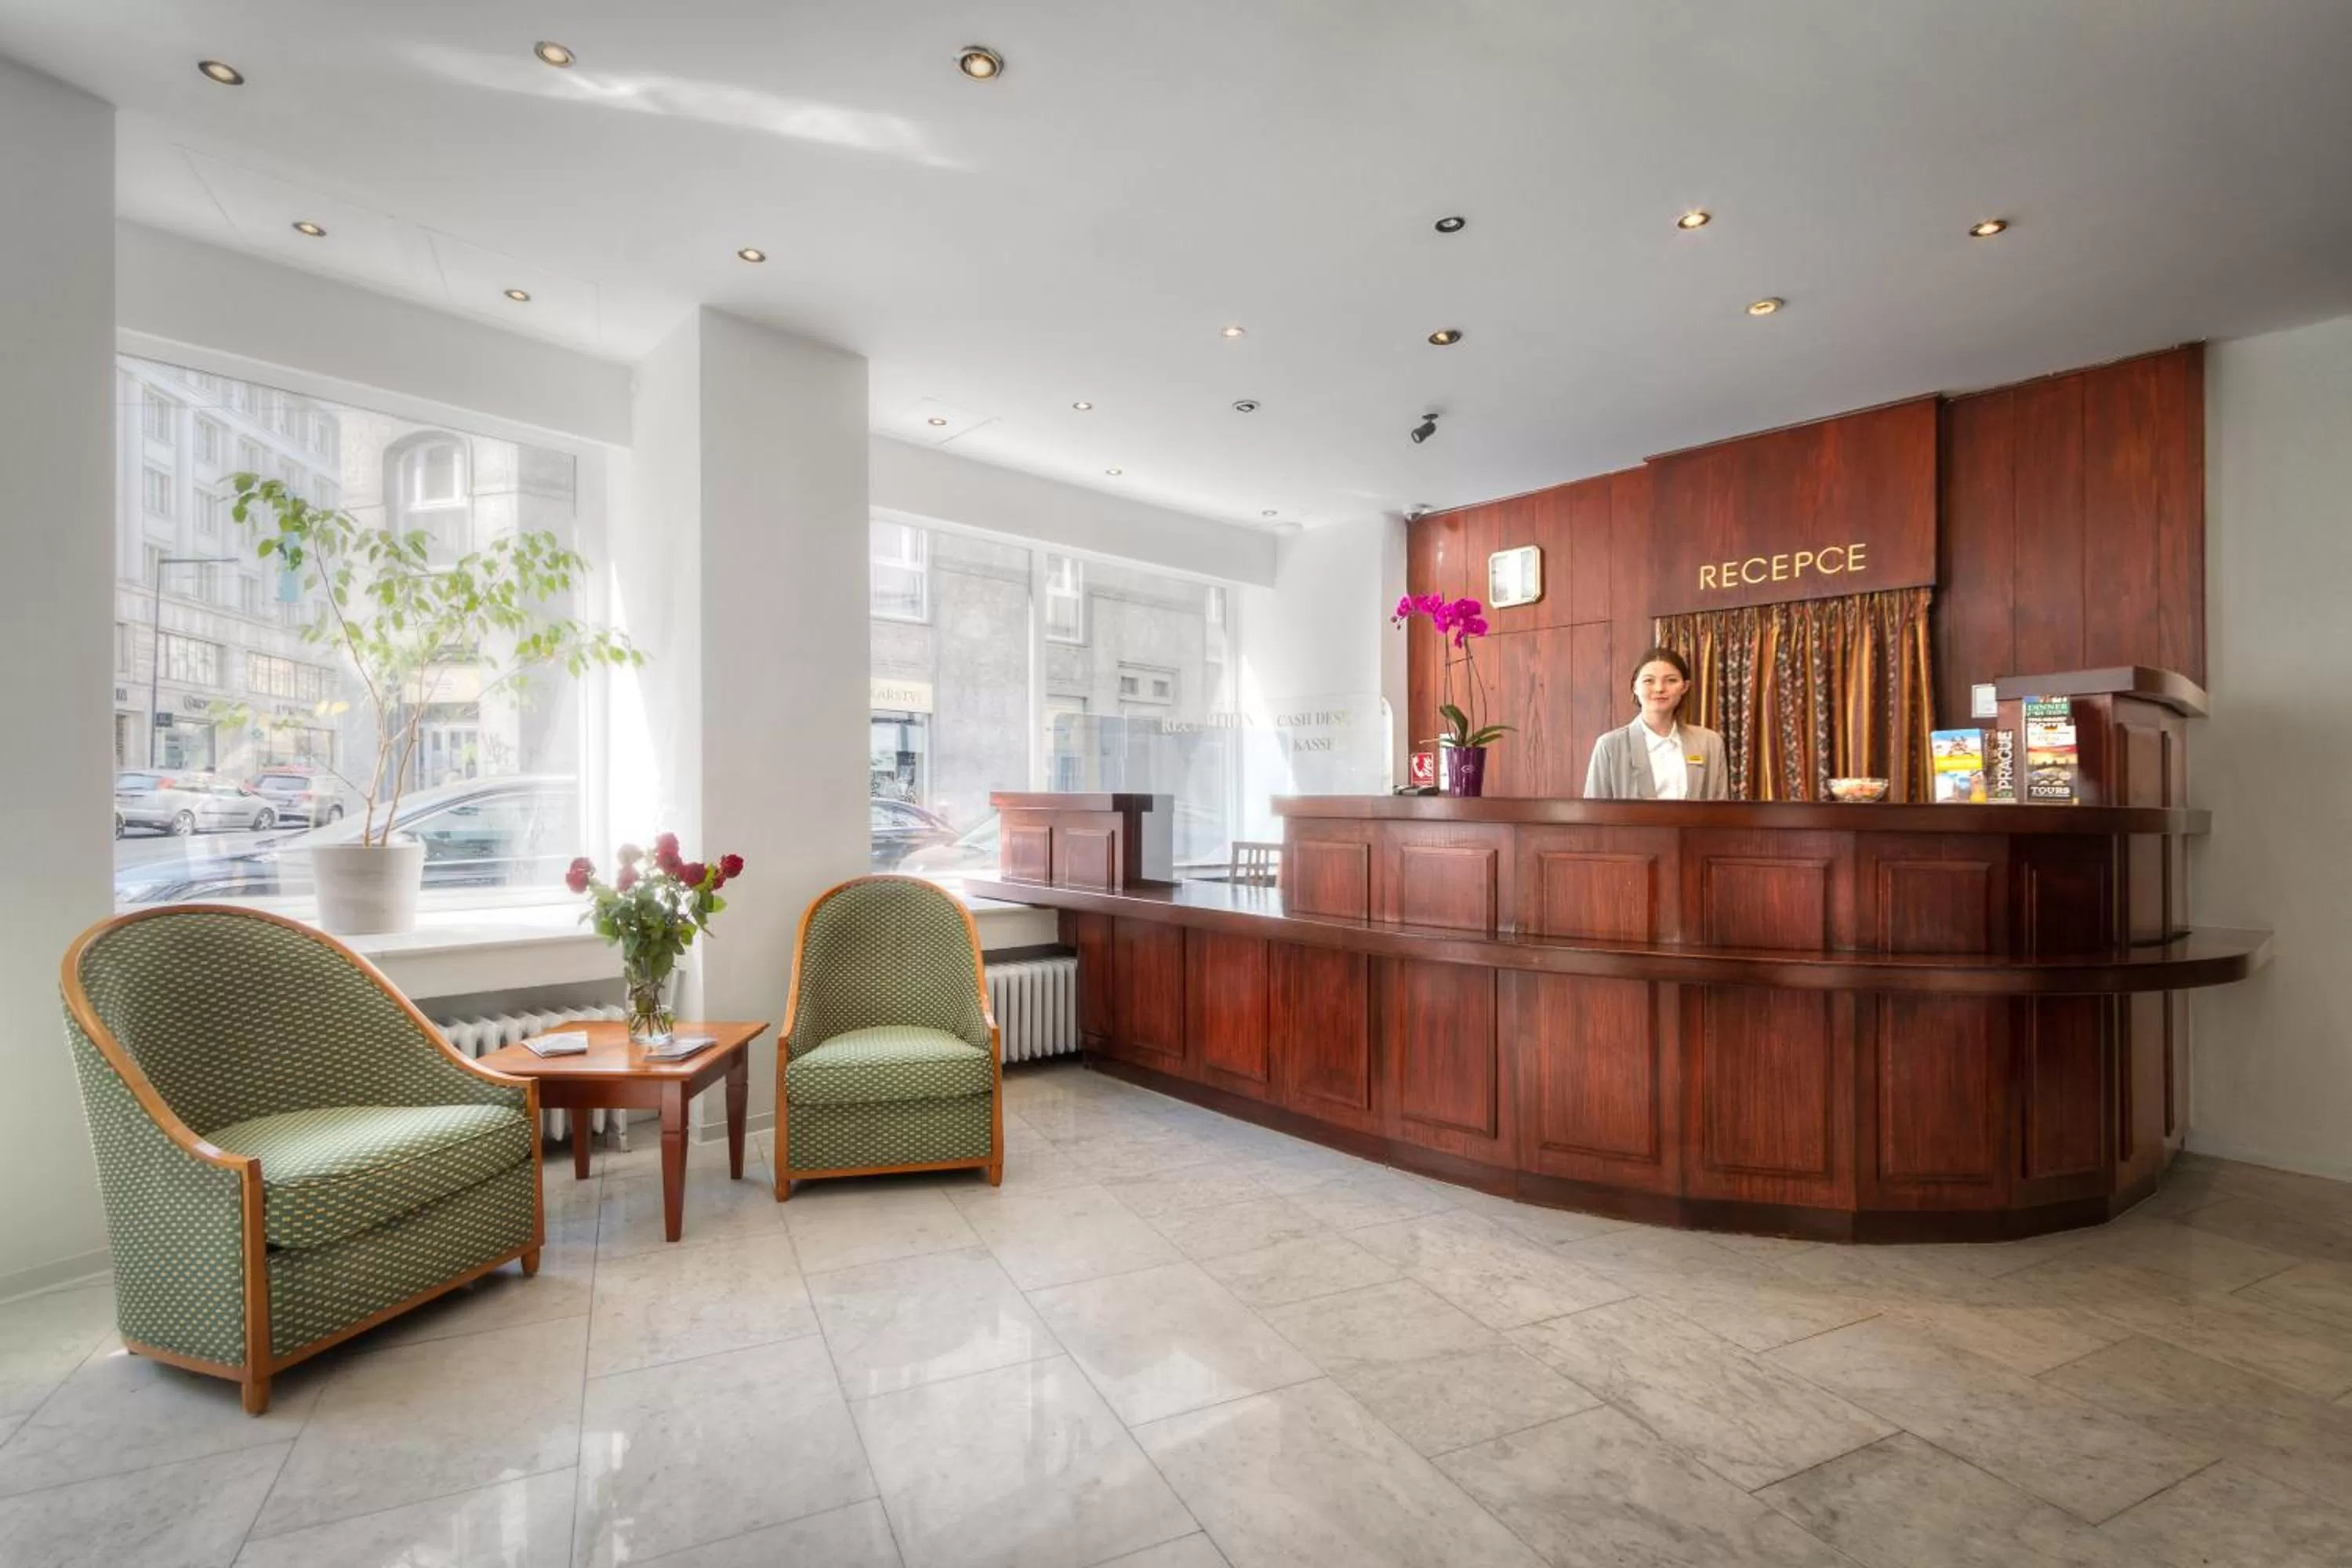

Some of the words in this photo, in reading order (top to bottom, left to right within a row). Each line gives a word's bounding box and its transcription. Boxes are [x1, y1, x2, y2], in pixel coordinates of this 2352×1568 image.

[1699, 543, 1867, 590] RECEPCE
[1276, 712, 1312, 728] CASH
[1997, 731, 2013, 790] PRAGUE
[2029, 786, 2071, 795] TOURS
